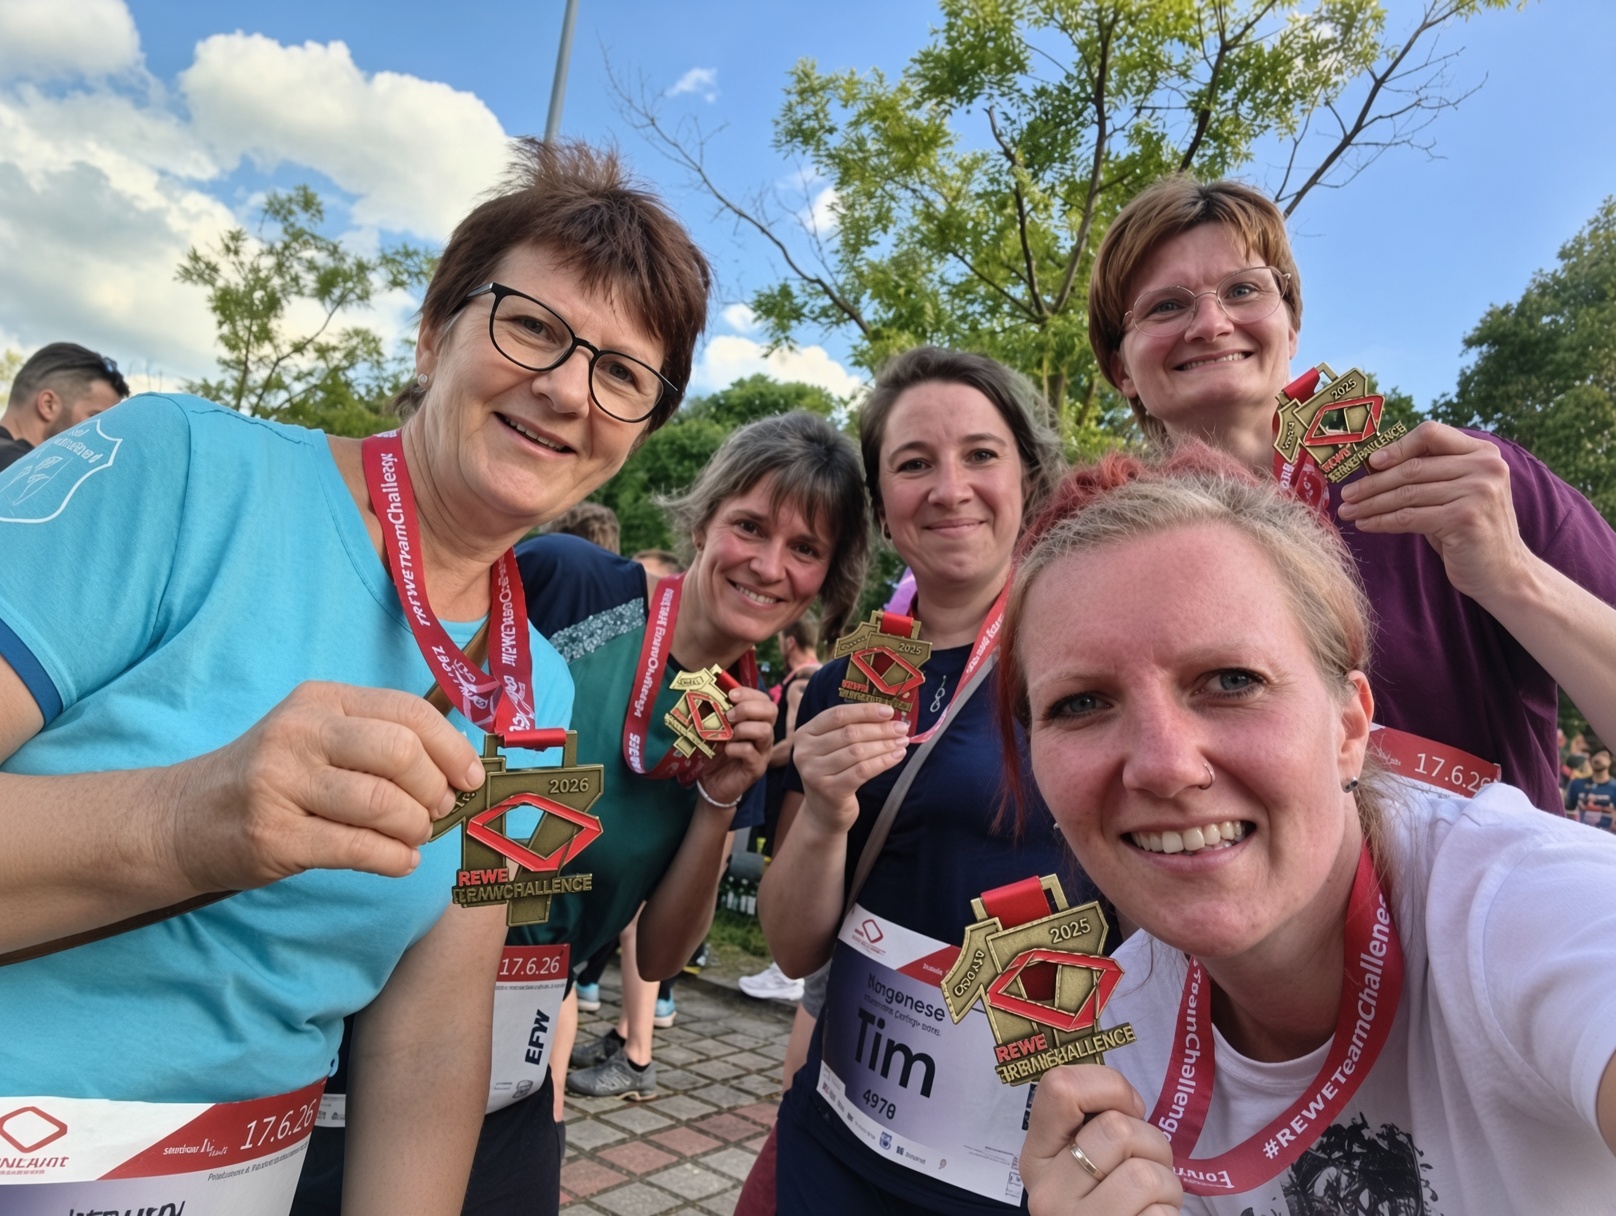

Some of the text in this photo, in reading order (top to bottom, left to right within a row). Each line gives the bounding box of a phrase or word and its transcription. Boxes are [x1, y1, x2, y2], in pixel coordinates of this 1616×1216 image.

[1331, 378, 1357, 400] 2025
[899, 642, 922, 655] 2025
[549, 778, 589, 794] 2026
[458, 868, 508, 887] REWE
[1049, 918, 1091, 943] 2025
[499, 956, 560, 976] 17.6.26
[524, 1008, 551, 1066] EFW
[995, 1033, 1048, 1063] REWE
[853, 1006, 937, 1099] Tim
[240, 1098, 317, 1151] 17.6.26
